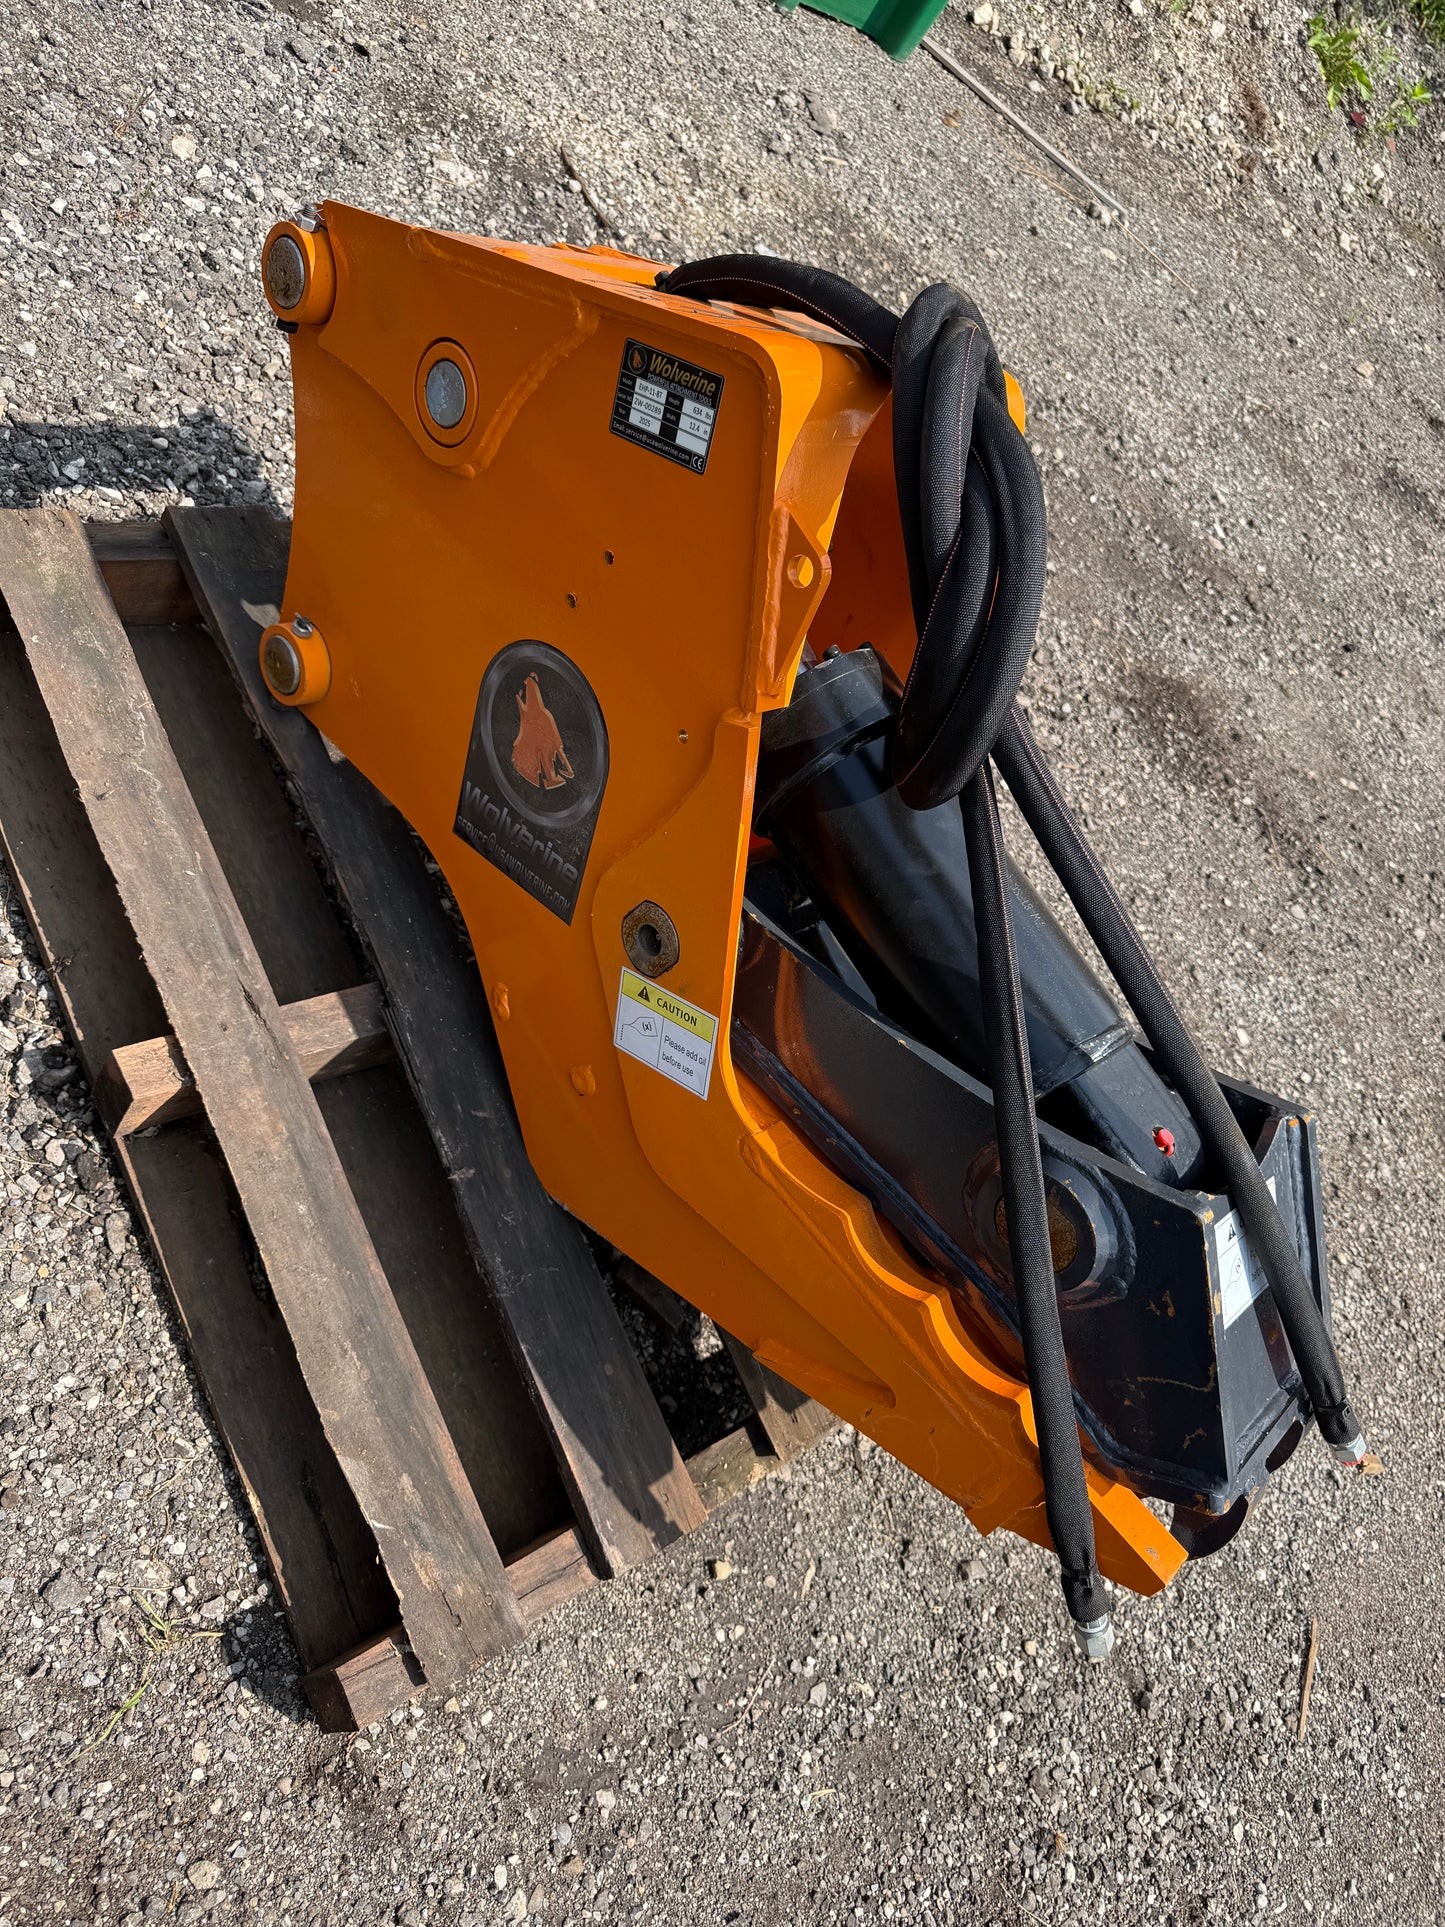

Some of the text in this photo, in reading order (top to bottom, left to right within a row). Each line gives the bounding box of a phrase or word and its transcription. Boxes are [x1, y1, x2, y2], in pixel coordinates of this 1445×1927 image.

[649, 353, 716, 396] Wolverine
[634, 397, 662, 415] ZW-00289
[670, 383, 698, 399] ATTACHMENT
[698, 394, 712, 406] TOOLS
[638, 416, 651, 428] 2025
[692, 406, 712, 420] 634 lbs
[689, 422, 700, 432] 12.4
[464, 780, 578, 883] Wolverine
[456, 815, 571, 912] SERVICE@USAWOLVERINE.COM
[656, 997, 698, 1027] CAUTION
[664, 1034, 707, 1067] Please add oil
[661, 1051, 694, 1077] before use
